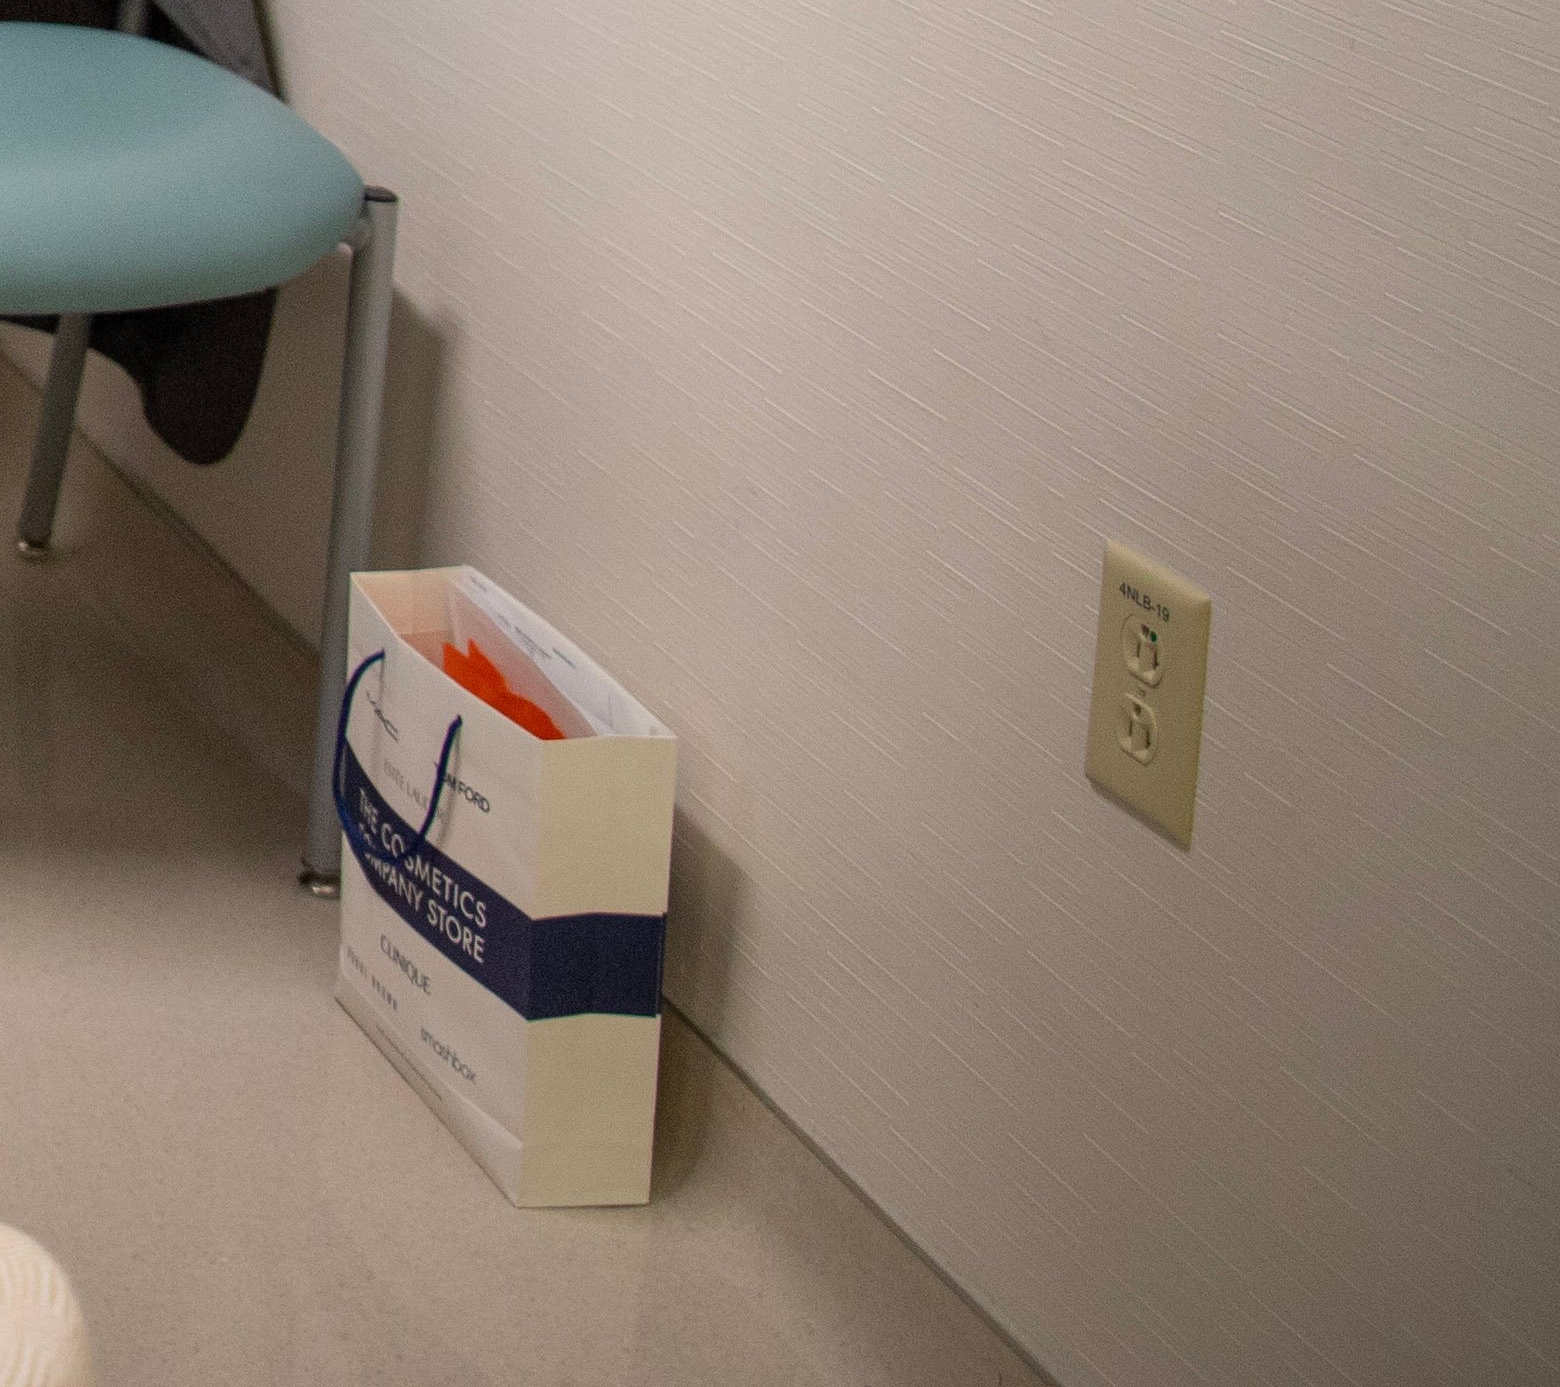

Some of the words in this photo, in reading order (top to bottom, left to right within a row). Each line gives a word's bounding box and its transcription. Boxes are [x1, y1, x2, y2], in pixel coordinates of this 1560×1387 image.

[1119, 582, 1170, 623] 4NLB-19
[358, 787, 378, 836] THE
[457, 781, 491, 813] FORD
[426, 898, 485, 964] STORE
[379, 933, 433, 996] CLINIQUE
[420, 1027, 478, 1085] smashbox
